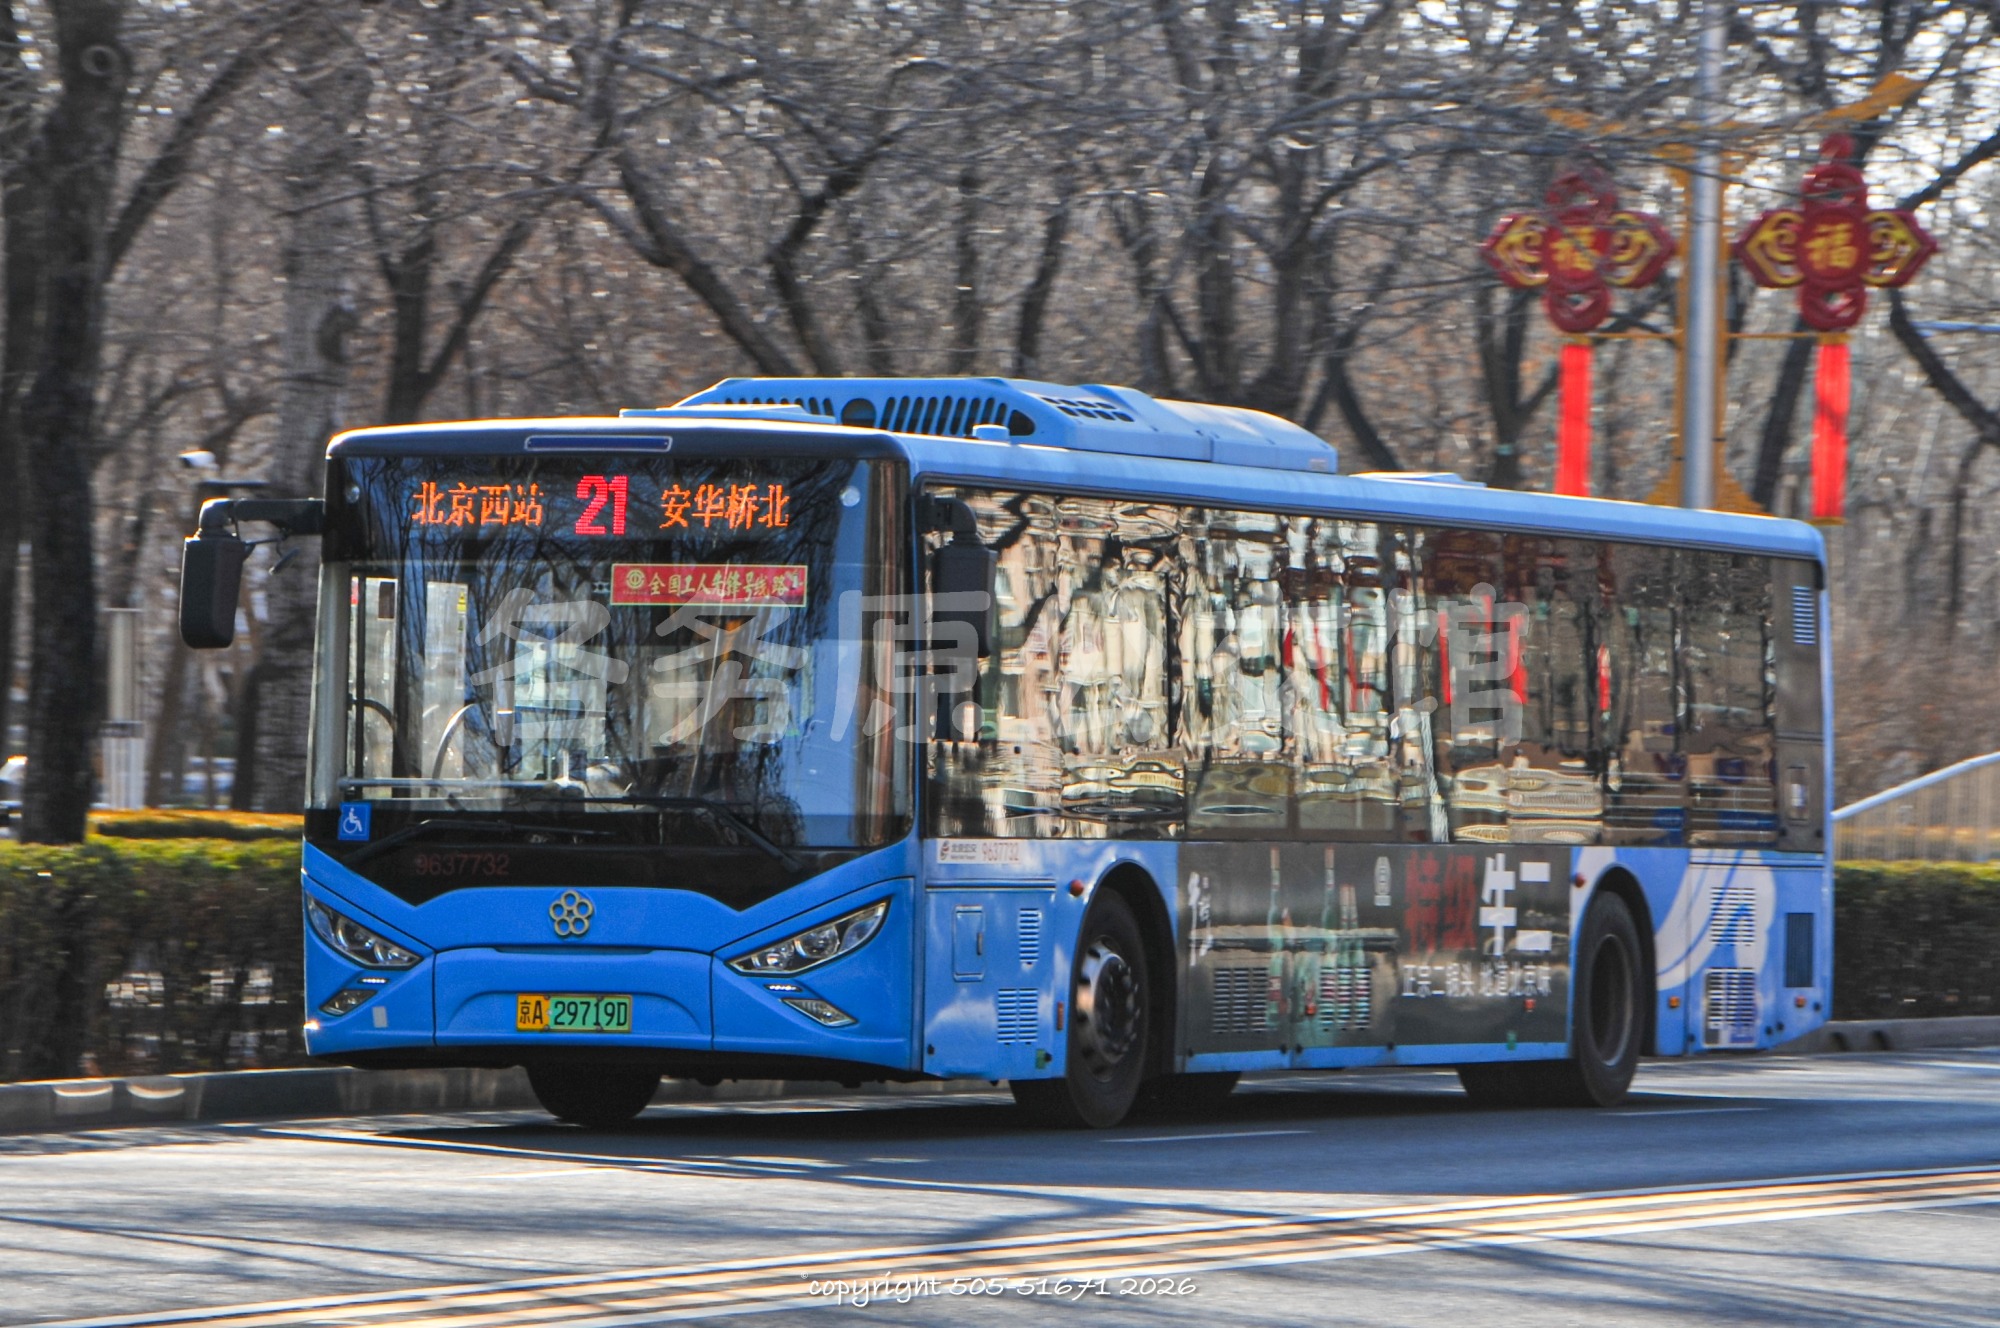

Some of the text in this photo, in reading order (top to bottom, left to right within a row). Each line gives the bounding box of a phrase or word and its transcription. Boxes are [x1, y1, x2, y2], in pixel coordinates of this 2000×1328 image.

[1806, 223, 1859, 270] 福
[412, 481, 543, 528] 北京西站
[575, 475, 628, 535] 21
[659, 483, 790, 530] 安华桥北
[415, 853, 510, 876] 9637732
